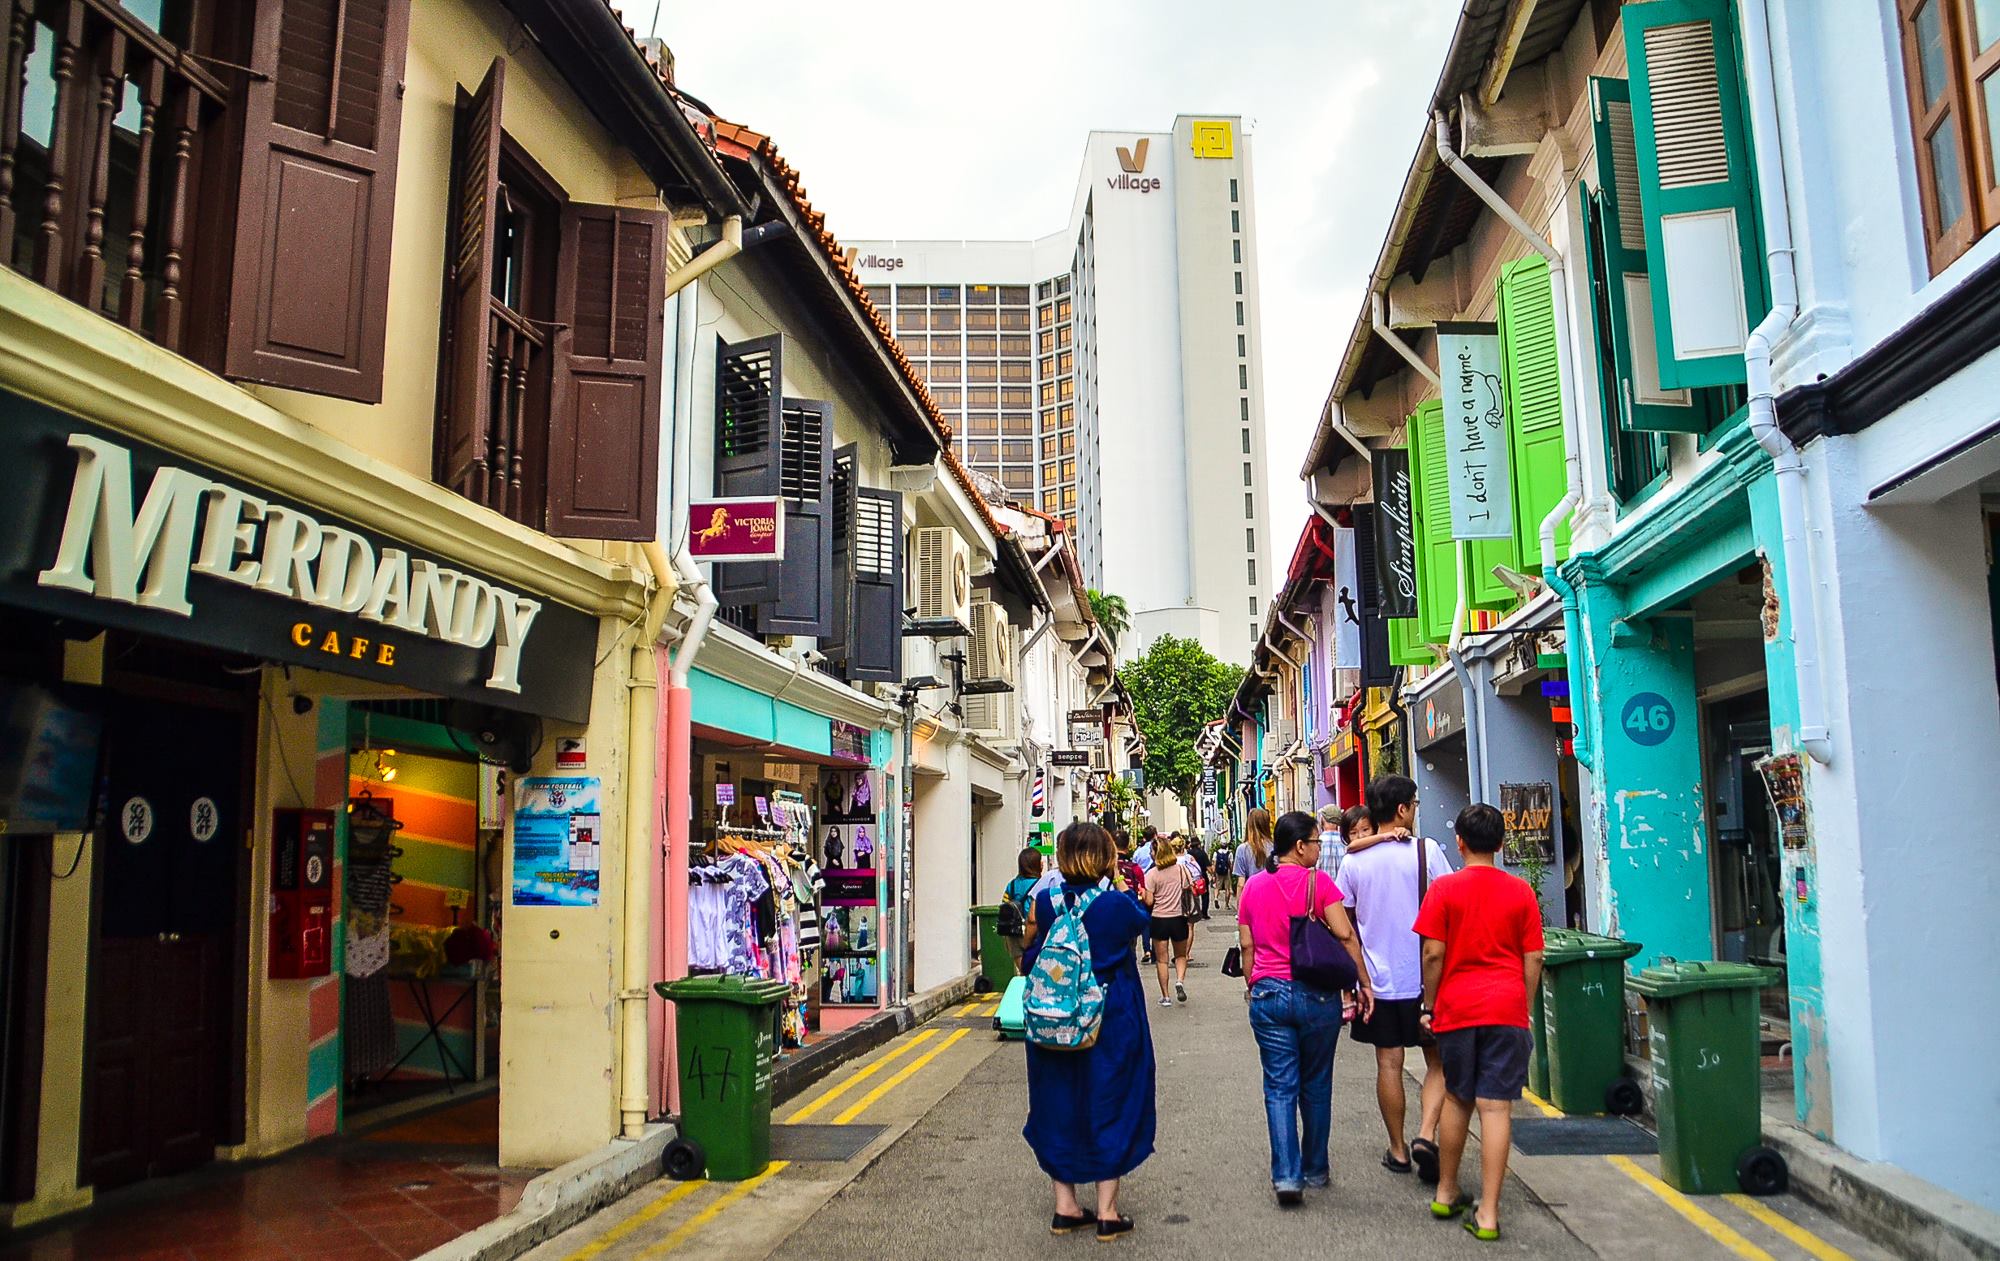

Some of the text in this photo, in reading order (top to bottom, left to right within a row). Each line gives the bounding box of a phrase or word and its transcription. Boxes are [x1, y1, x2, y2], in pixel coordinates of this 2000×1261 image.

[1107, 174, 1161, 193] village
[858, 255, 904, 271] village
[1463, 398, 1476, 410] a
[1459, 414, 1486, 452] have
[1464, 460, 1488, 503] don't
[734, 517, 775, 526] VICTORIA
[1468, 509, 1490, 522] I
[1379, 469, 1417, 598] Simplicity
[37, 433, 542, 694] MERDANDY
[290, 622, 397, 667] CAFE
[1626, 704, 1670, 732] 46
[1503, 807, 1551, 831] RAW
[1582, 982, 1605, 997] 49
[688, 1045, 740, 1102] 47
